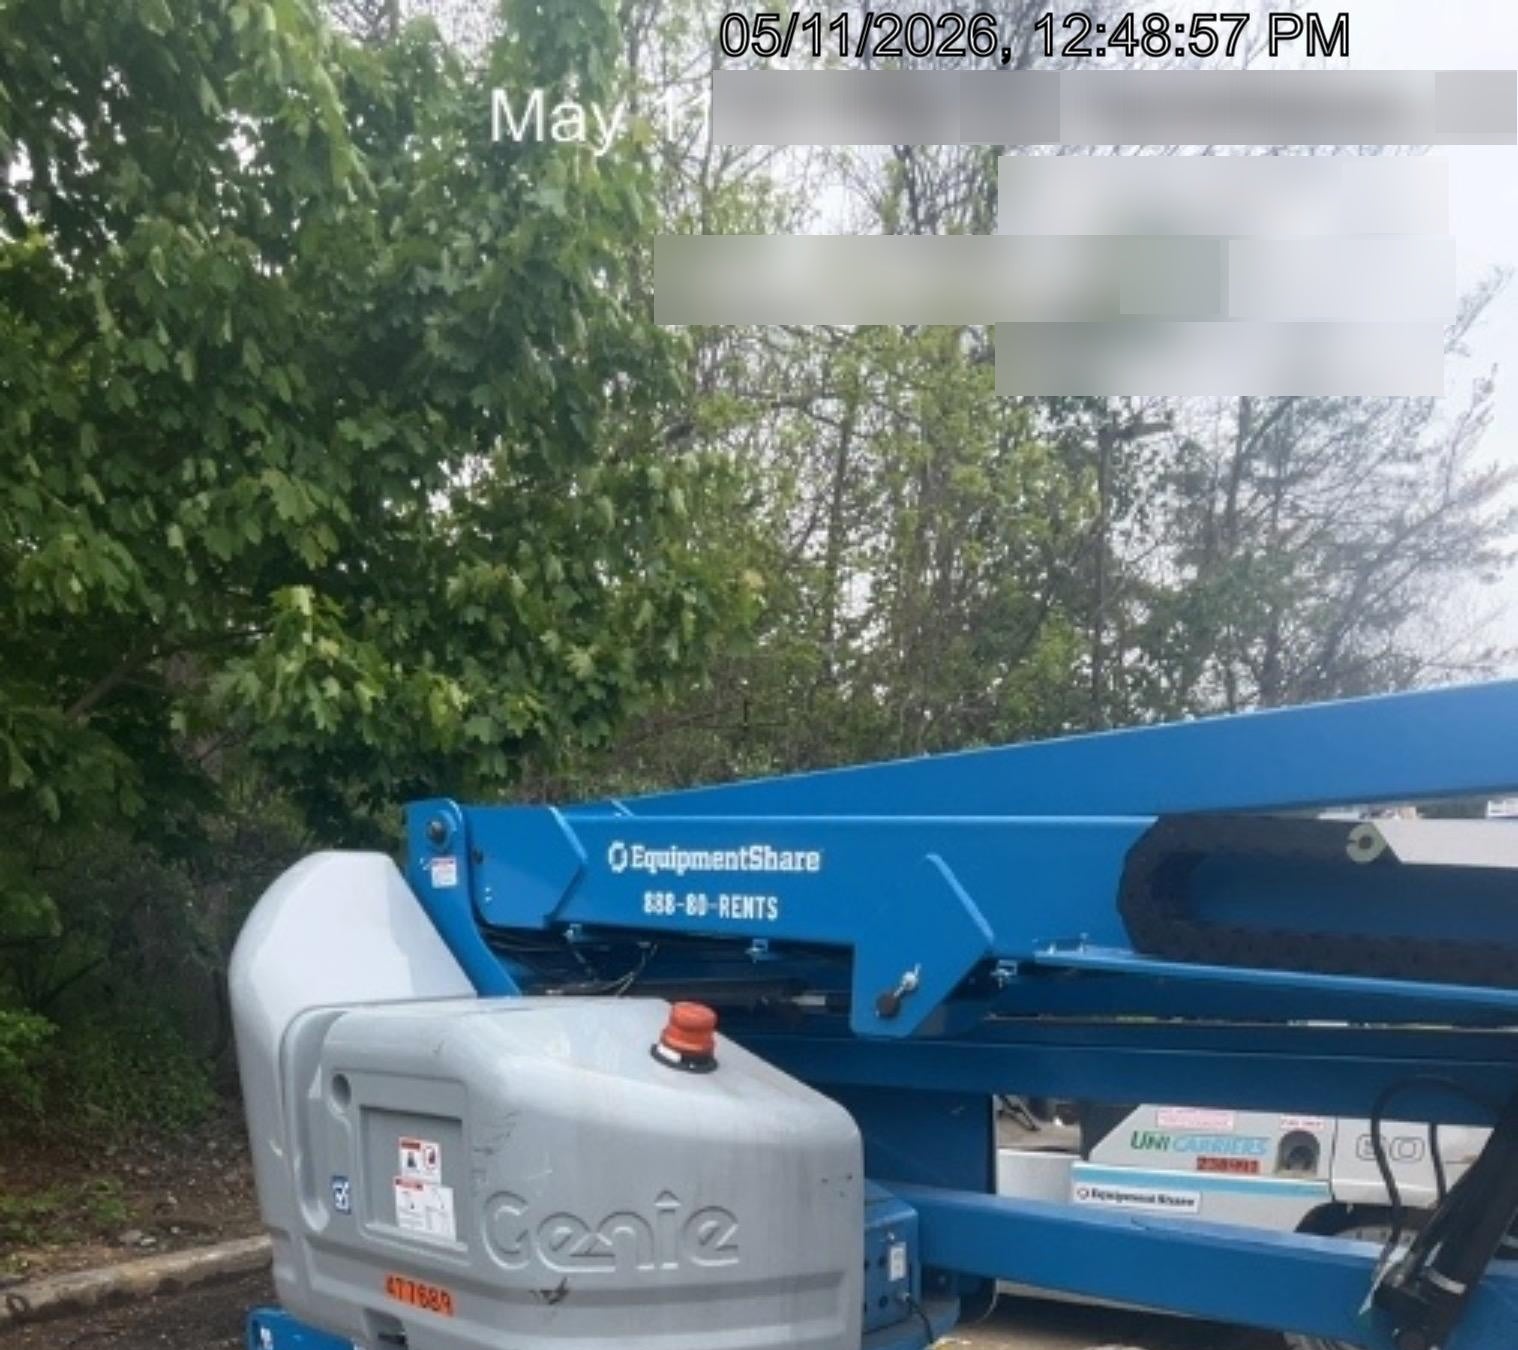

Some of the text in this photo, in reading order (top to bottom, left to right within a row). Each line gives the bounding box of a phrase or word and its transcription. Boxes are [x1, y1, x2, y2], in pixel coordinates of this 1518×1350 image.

[631, 844, 820, 876] EquipmentShare
[643, 891, 779, 921] 888-80-RENTS
[480, 1190, 740, 1273] Genie
